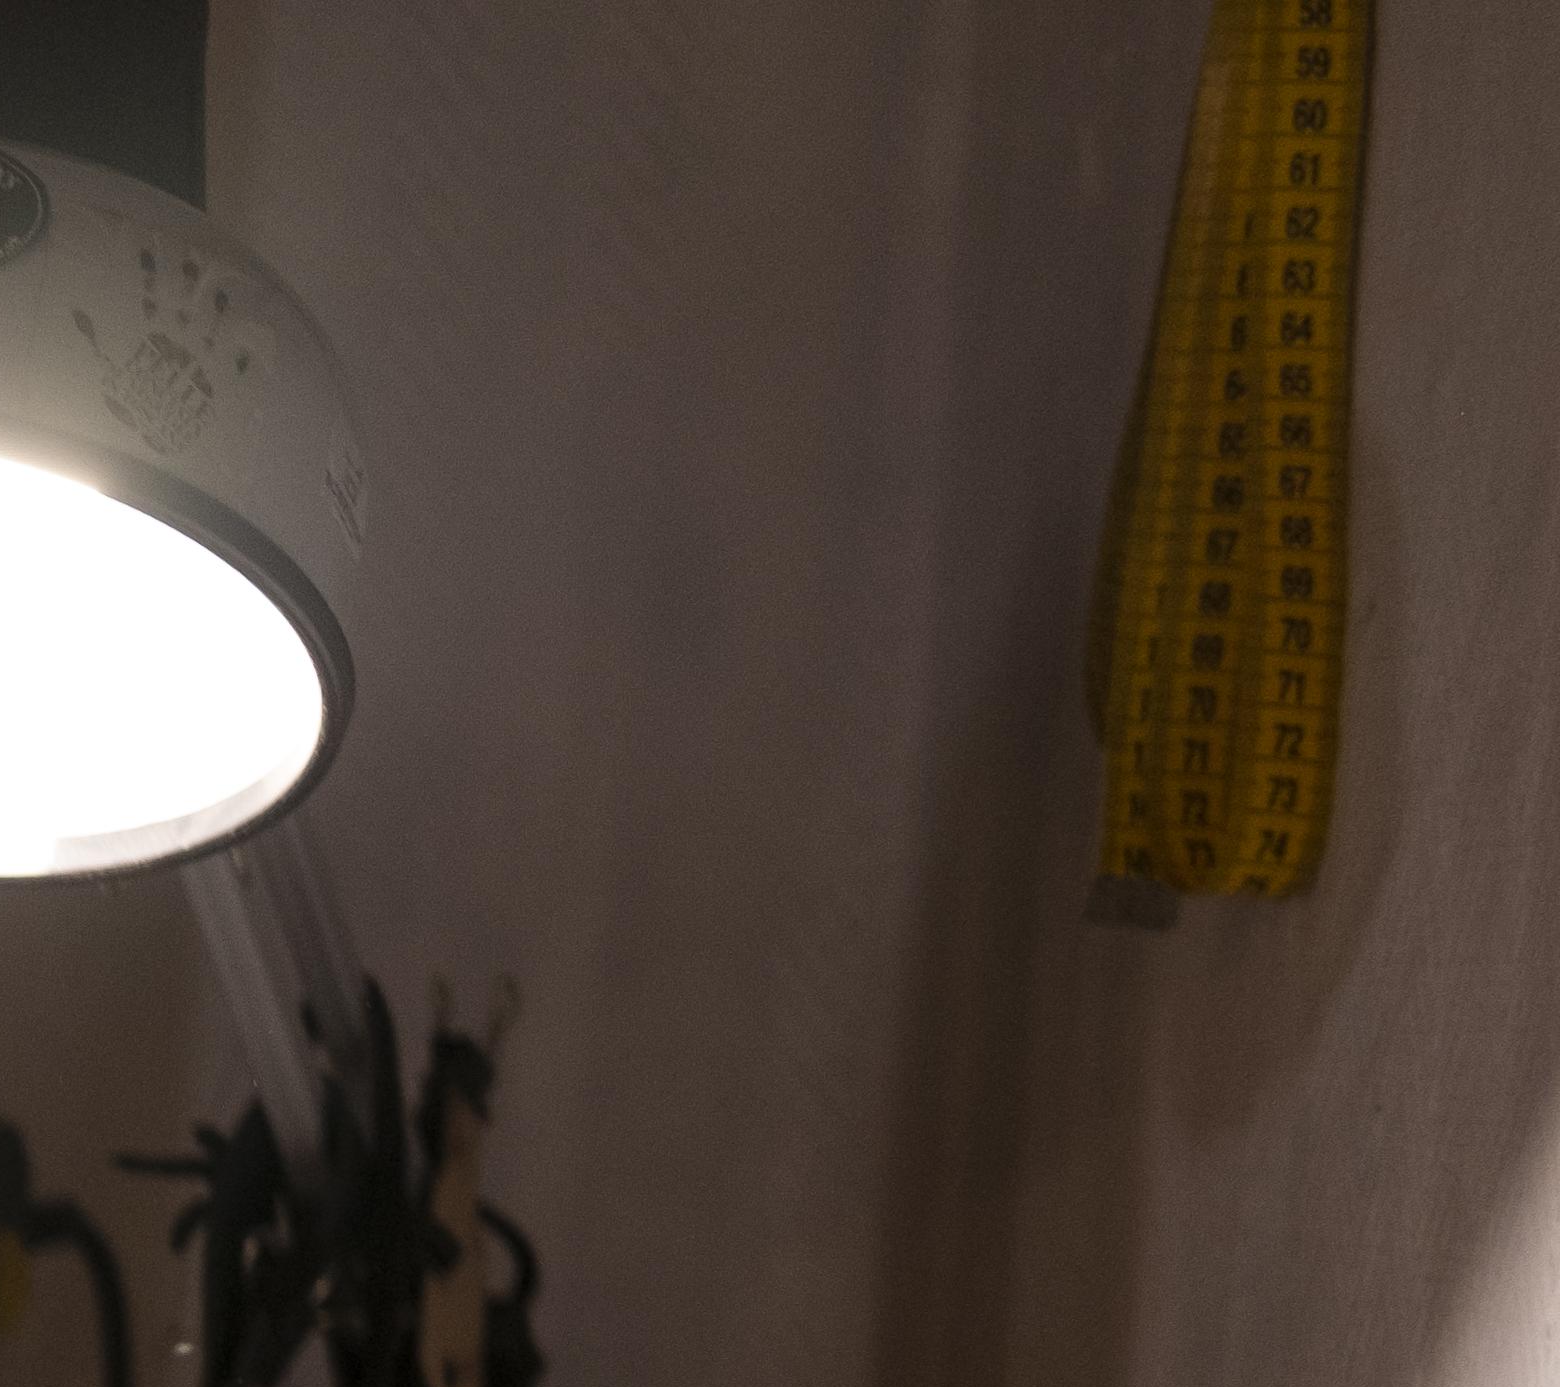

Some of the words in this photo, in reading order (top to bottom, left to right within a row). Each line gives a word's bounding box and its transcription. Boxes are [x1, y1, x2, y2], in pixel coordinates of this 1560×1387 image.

[1297, 46, 1332, 79] 59
[1292, 98, 1328, 131] 60
[1290, 152, 1322, 186] 61
[1287, 206, 1320, 240] 62
[1283, 260, 1315, 294] 63
[1280, 467, 1313, 498] 67
[1283, 618, 1313, 652] 70
[1279, 670, 1306, 702] 71
[1184, 738, 1210, 772] 71
[1274, 724, 1305, 758] 72
[1268, 777, 1298, 810] 73
[1257, 831, 1288, 862] 74
